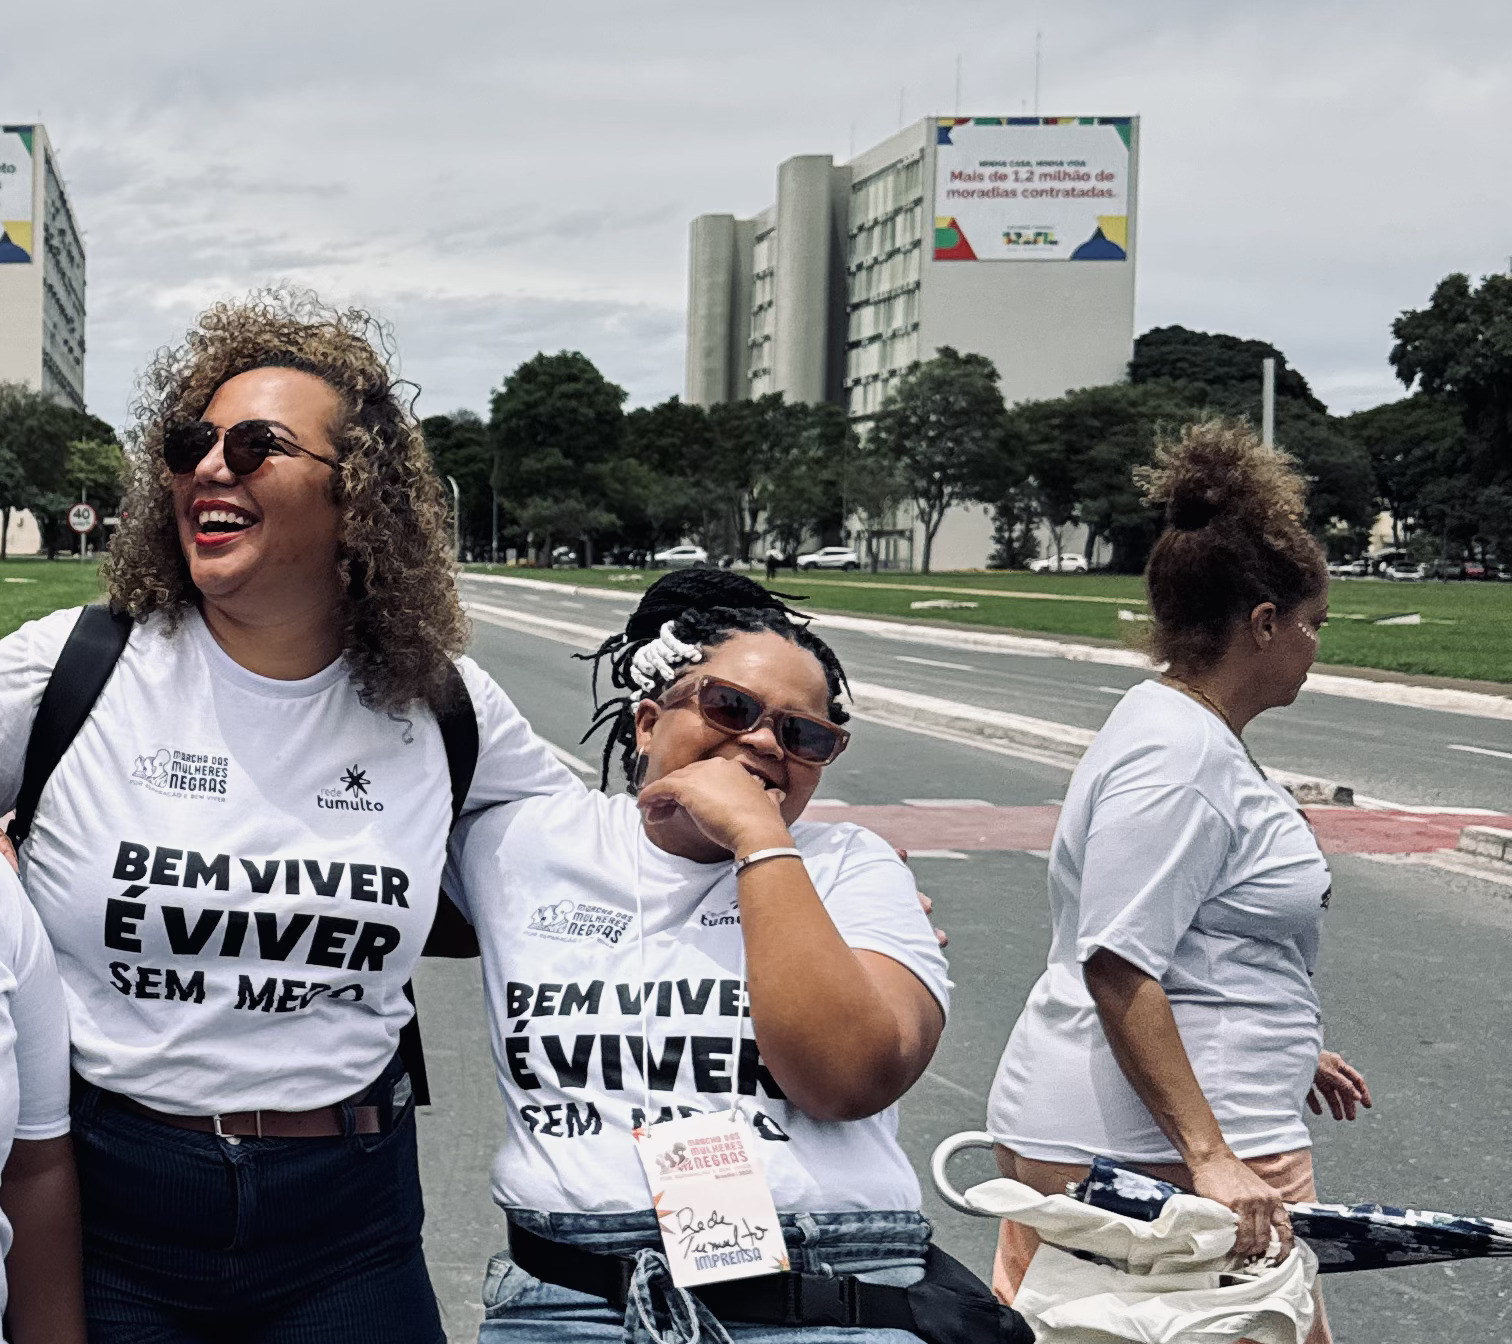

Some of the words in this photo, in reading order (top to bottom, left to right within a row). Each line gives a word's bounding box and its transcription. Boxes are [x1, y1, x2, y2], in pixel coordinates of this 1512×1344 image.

[950, 169, 984, 183] Mais
[988, 170, 1009, 182] de
[1038, 169, 1091, 183] milhão
[1094, 169, 1116, 182] de
[946, 186, 1018, 199] moradias
[1021, 186, 1117, 199] contratadas.
[72, 507, 91, 520] 40
[173, 750, 209, 764] MARCHA
[211, 756, 229, 767] DAS
[171, 761, 228, 778] MULHERES
[169, 773, 227, 794] NEGRAS
[320, 788, 343, 798] rede
[316, 795, 385, 812] tumulto
[112, 840, 231, 892] BEM
[238, 857, 410, 909] VIVER
[104, 884, 151, 954] É
[161, 905, 401, 972] VIVER
[572, 911, 629, 931] MULHERES
[567, 922, 623, 944] NEGRAS
[108, 961, 206, 1005] SEM
[507, 980, 605, 1019] BEM
[616, 978, 750, 1017] VIVE
[505, 1019, 542, 1090] É
[520, 1102, 603, 1138] SEM
[690, 1141, 744, 1156] MULHERES
[694, 1151, 749, 1170] NEGRAS
[694, 1247, 763, 1271] IMPRENSA
